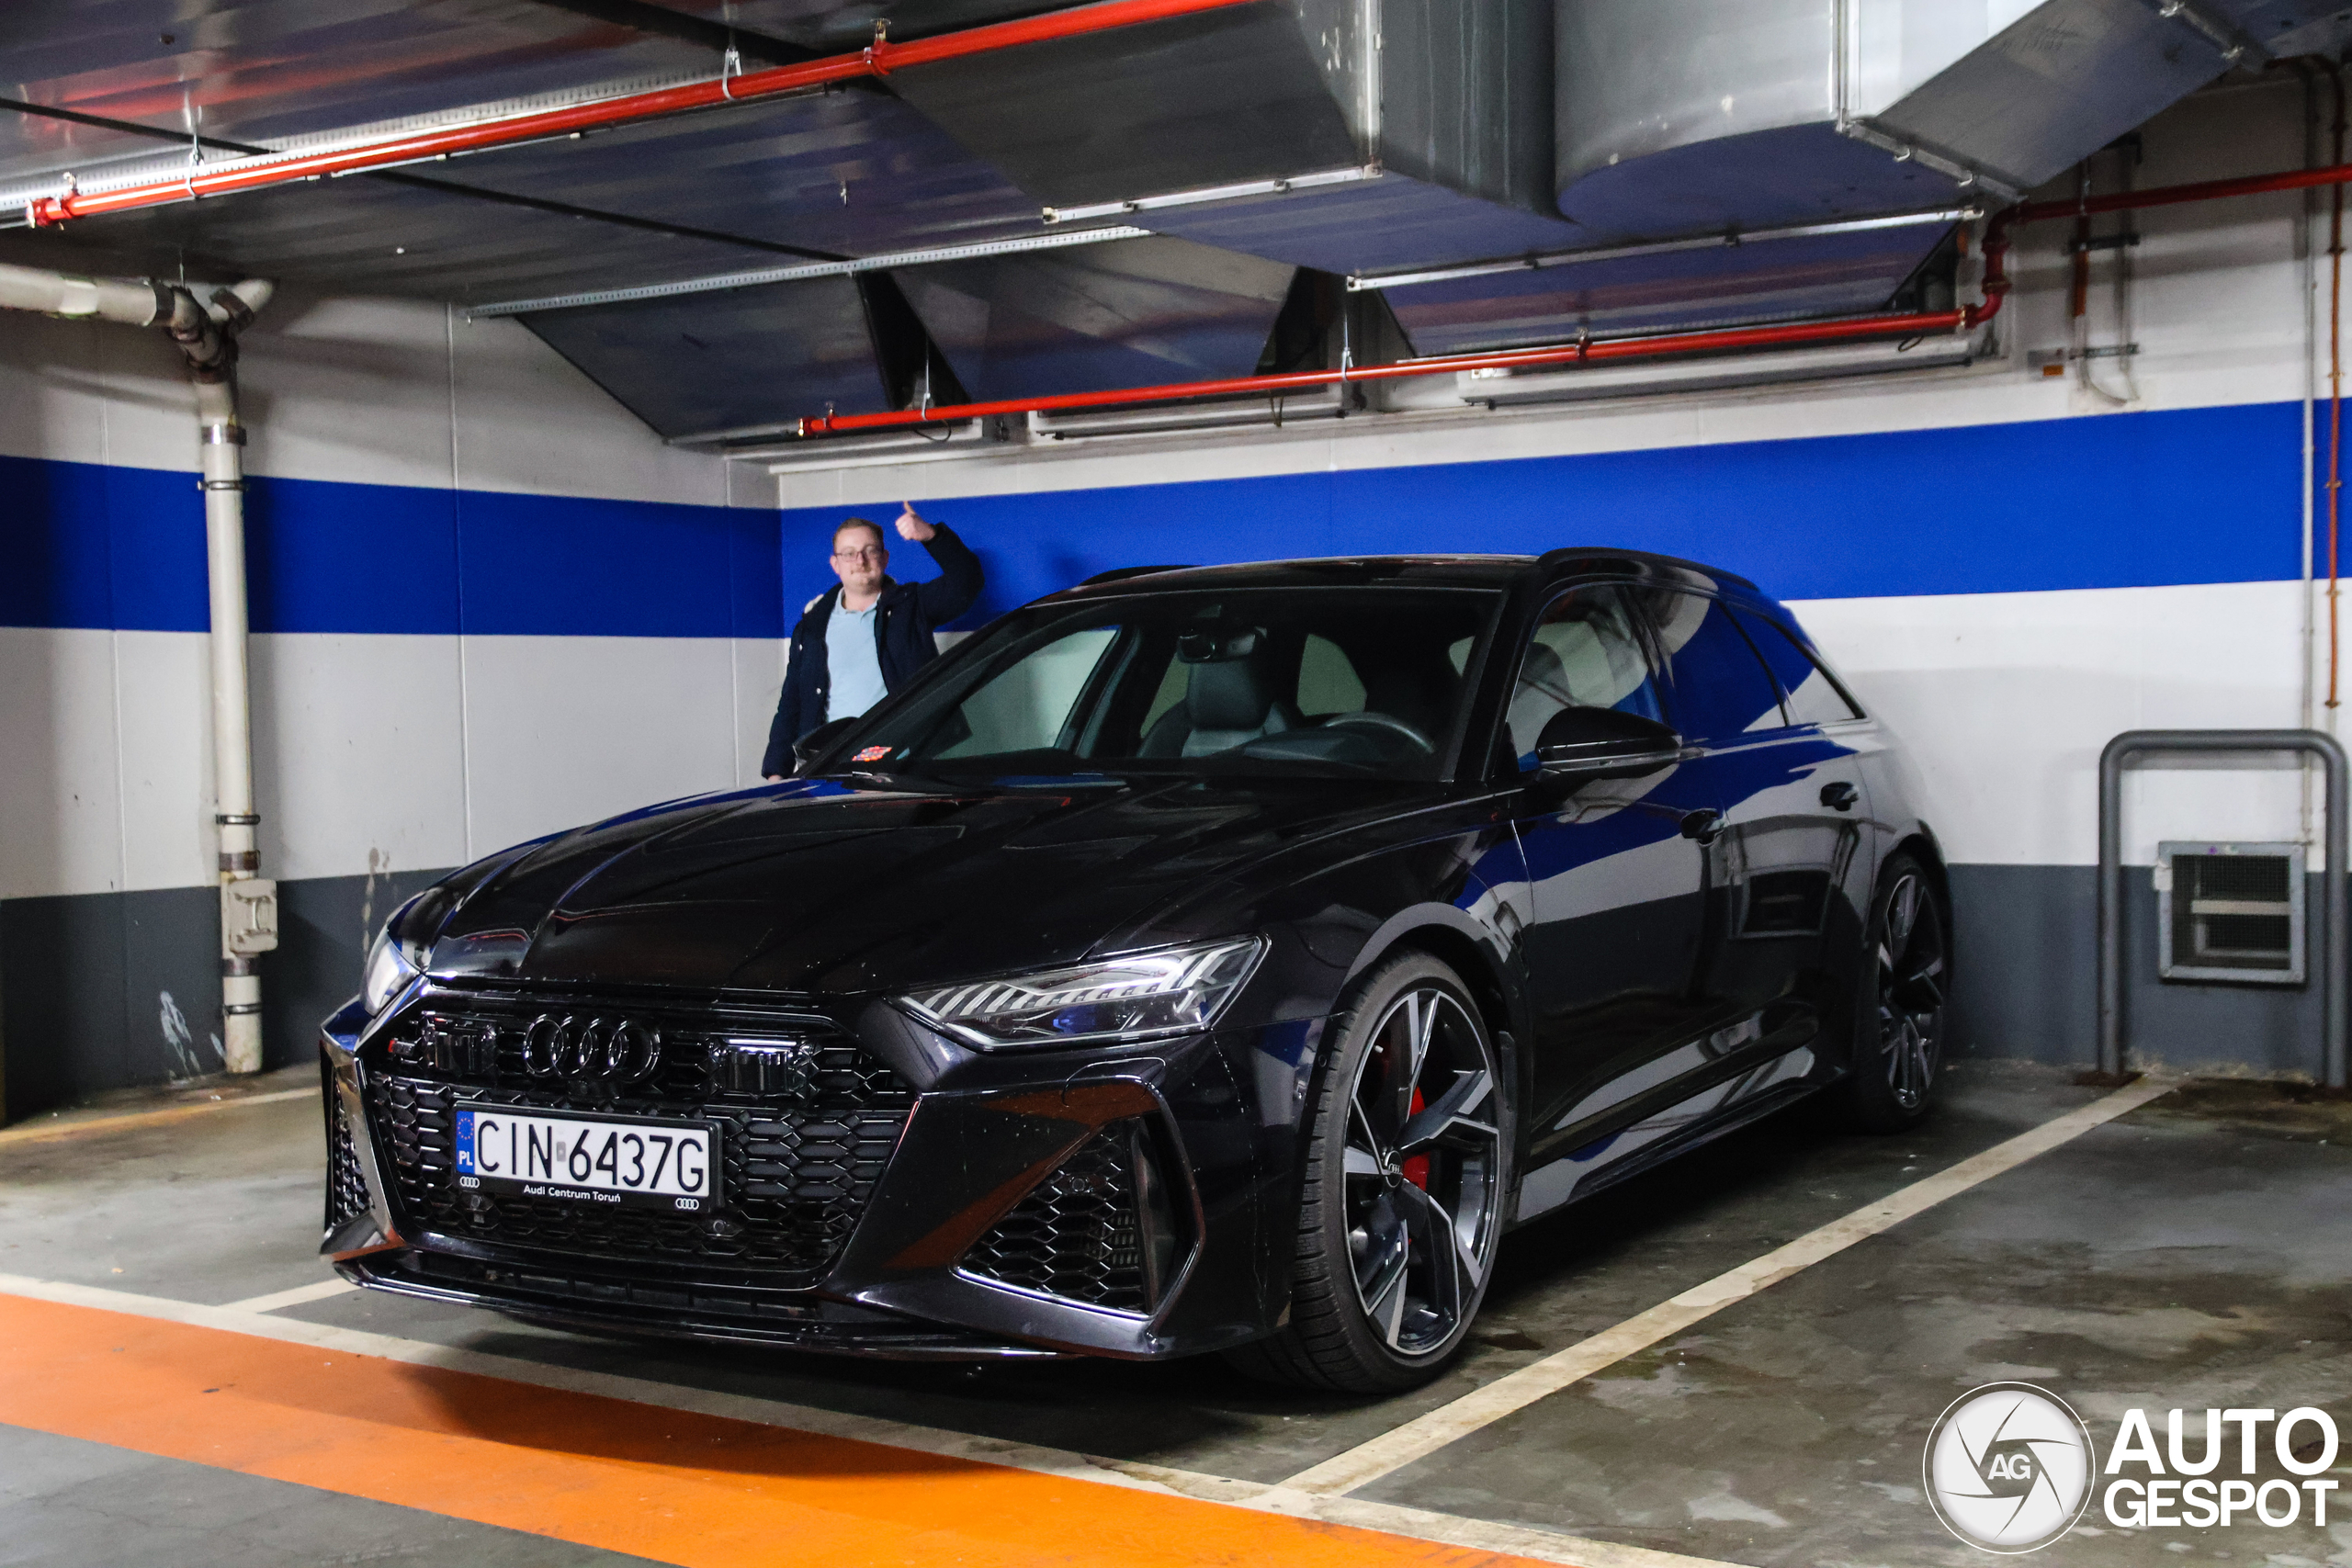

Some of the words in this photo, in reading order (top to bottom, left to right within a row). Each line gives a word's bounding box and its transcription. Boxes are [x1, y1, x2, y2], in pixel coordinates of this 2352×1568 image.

[458, 1150, 473, 1167] PL
[478, 1120, 552, 1179] CIN
[569, 1128, 704, 1192] 6437G
[523, 1183, 546, 1195] Audi
[548, 1186, 591, 1201] Centrum
[593, 1190, 621, 1202] Toruń
